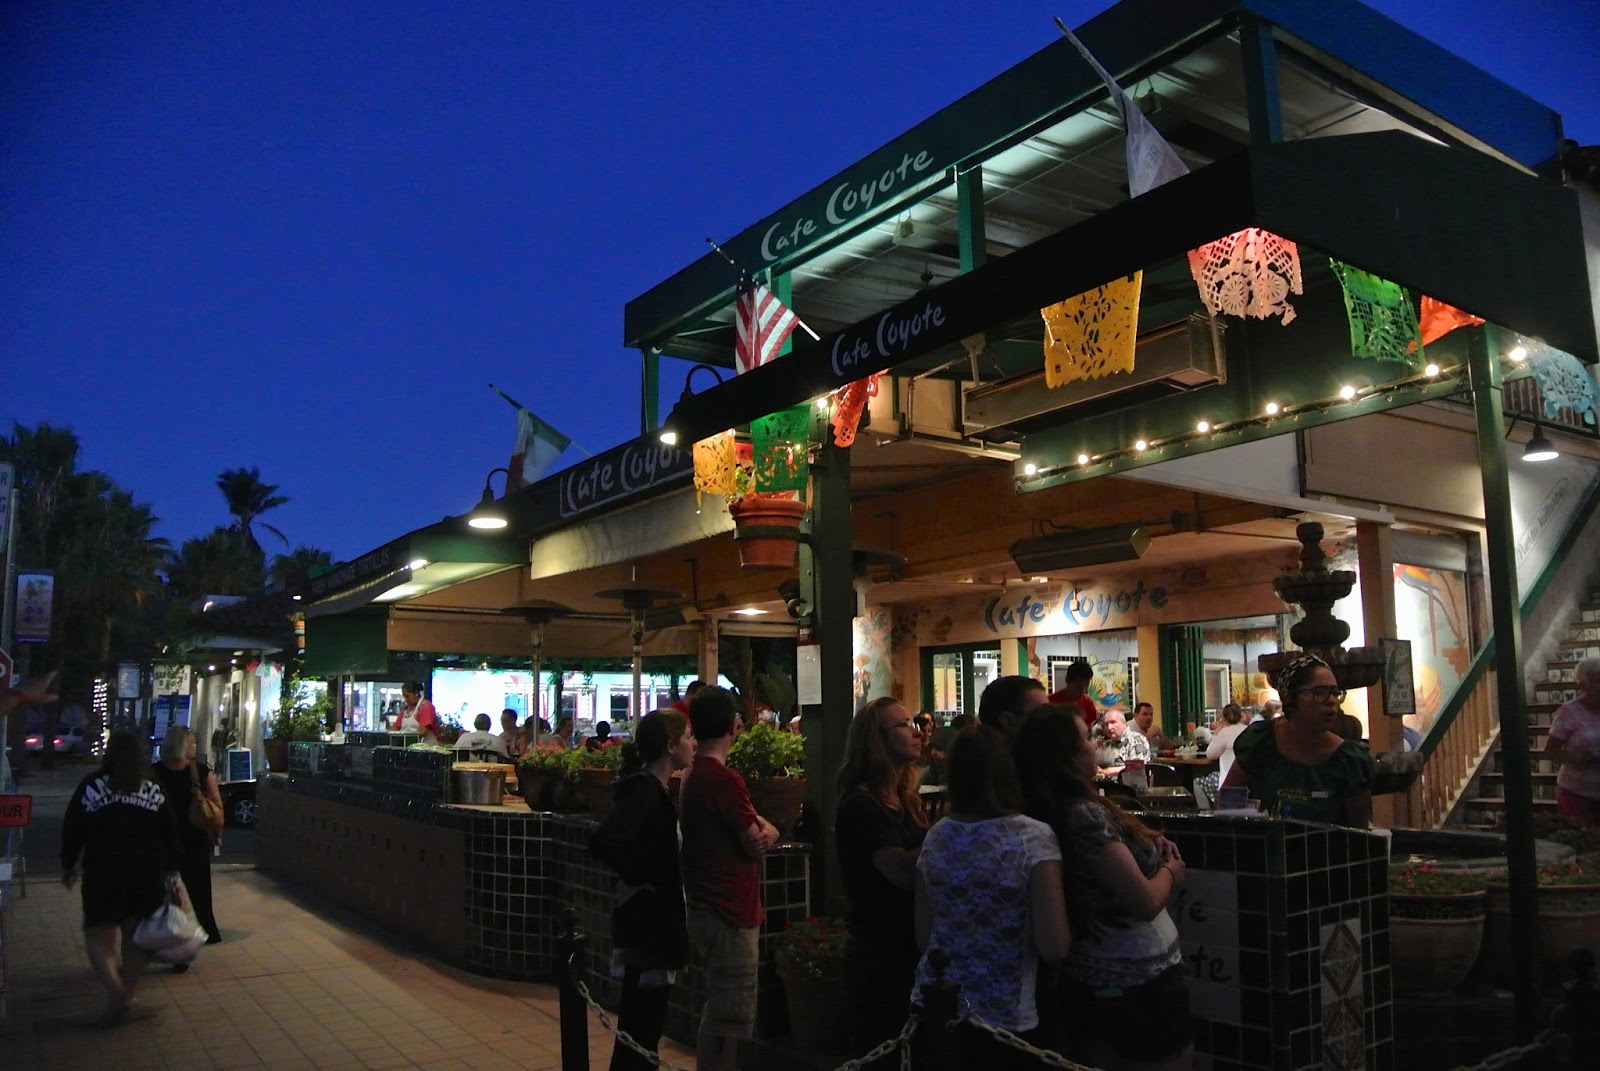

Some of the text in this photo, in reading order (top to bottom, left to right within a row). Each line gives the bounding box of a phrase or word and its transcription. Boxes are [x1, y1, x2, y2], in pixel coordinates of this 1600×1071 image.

[760, 149, 935, 262] Cafe Coyote
[831, 301, 946, 377] Cafe Coyote
[566, 446, 691, 512] Cafe Coyo
[984, 579, 1169, 633] Cafe Coyote
